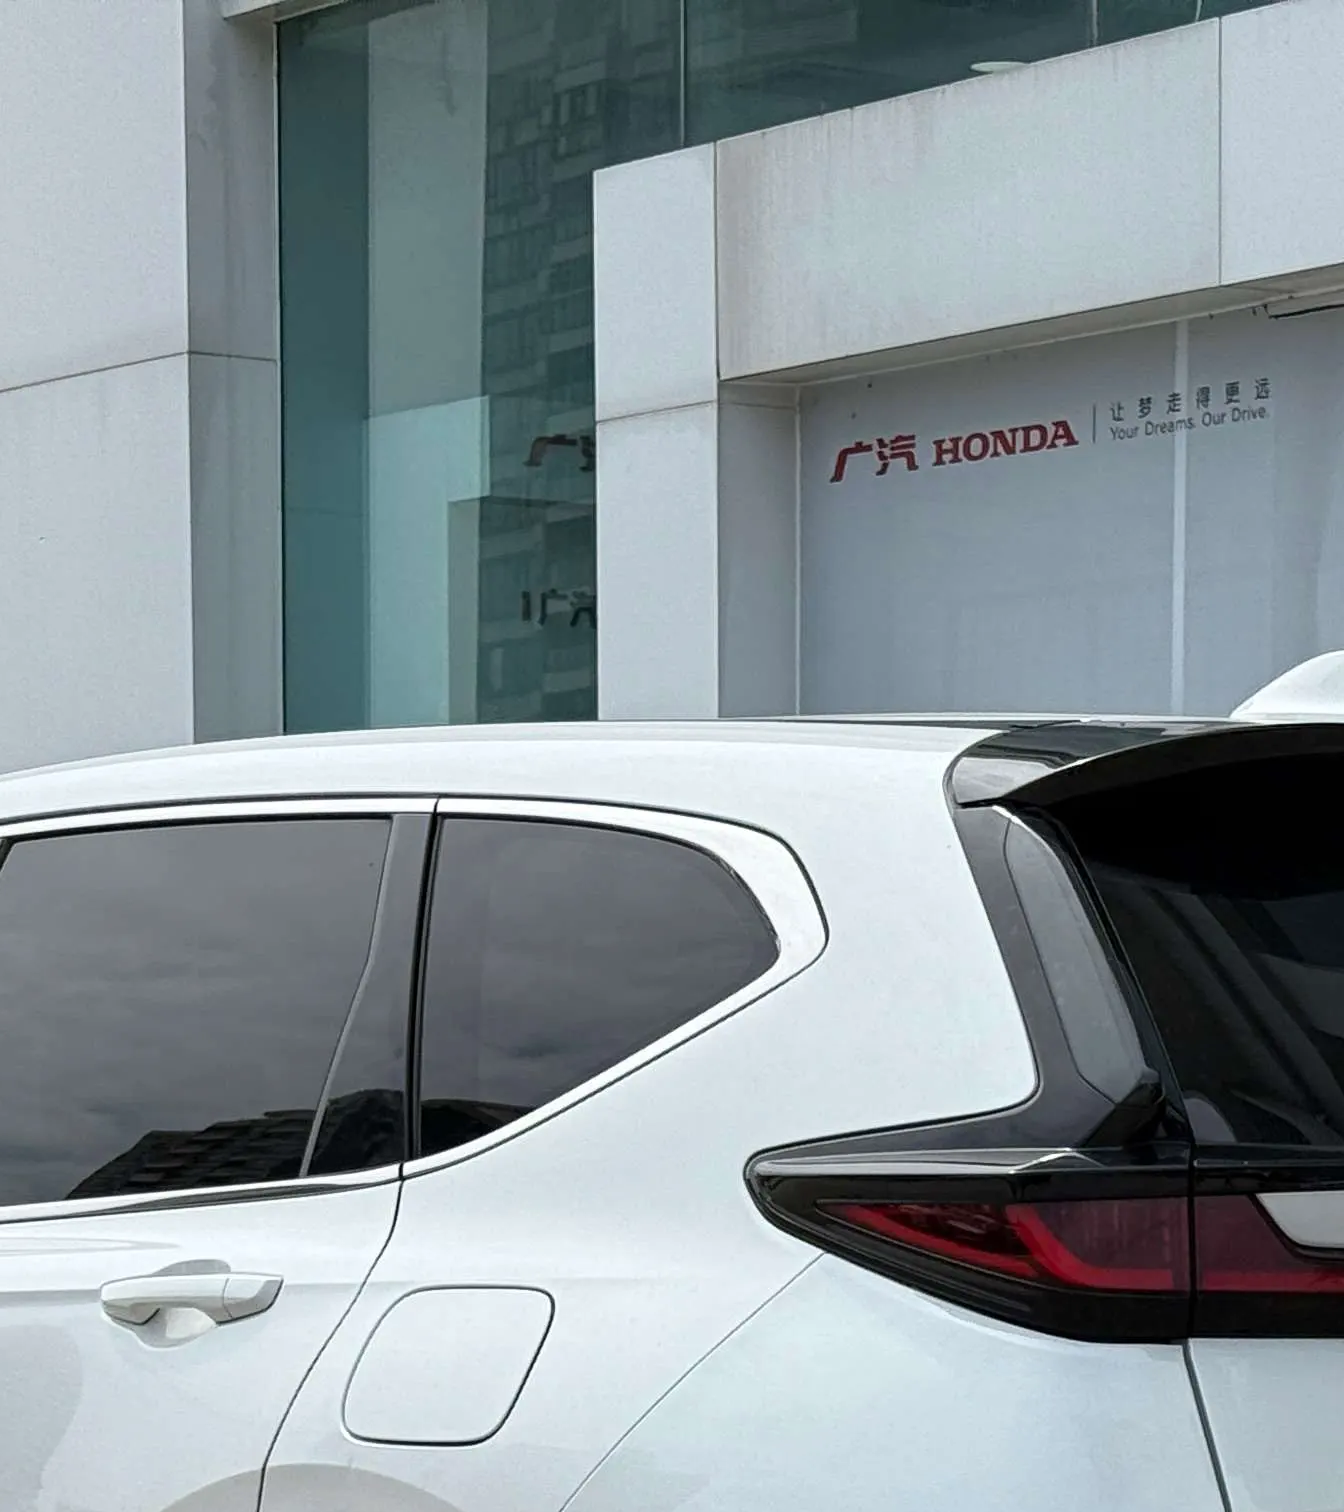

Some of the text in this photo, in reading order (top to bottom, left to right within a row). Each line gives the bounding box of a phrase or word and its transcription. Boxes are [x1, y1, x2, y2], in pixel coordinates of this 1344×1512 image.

[1110, 424, 1140, 441] Your
[1201, 411, 1226, 428] Our
[829, 420, 1080, 484] 广汽 HONDA
